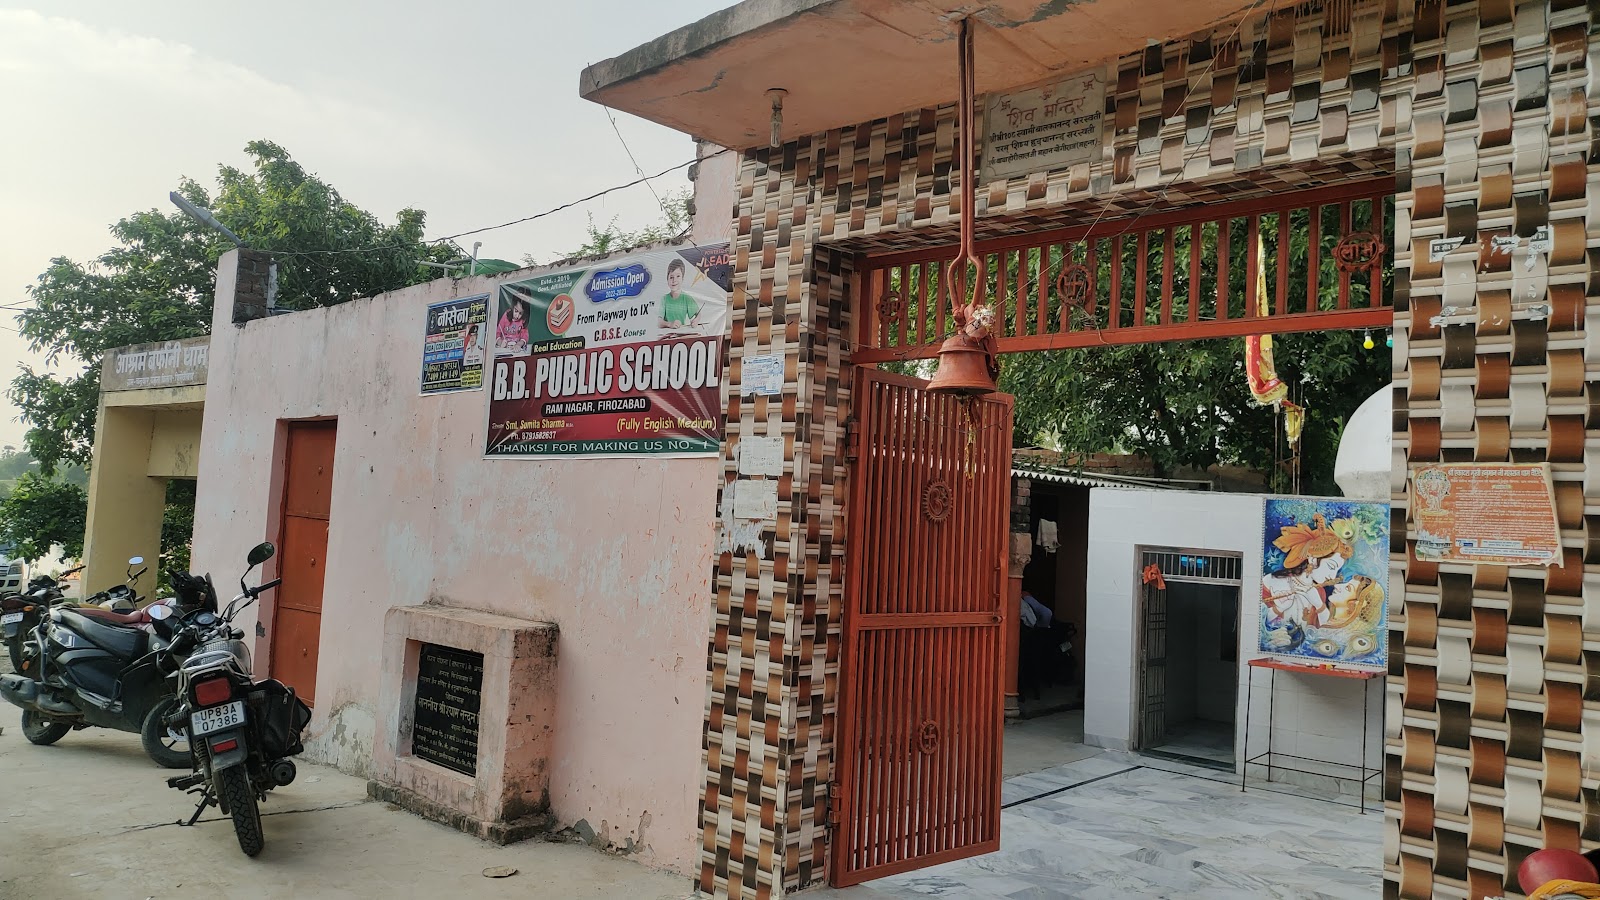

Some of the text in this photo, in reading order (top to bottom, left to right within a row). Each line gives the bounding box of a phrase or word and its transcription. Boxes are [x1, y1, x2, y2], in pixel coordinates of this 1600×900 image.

[1006, 96, 1086, 129] शिव मन्दिर
[1073, 110, 1101, 126] सरस्वती
[1066, 125, 1096, 138] सरस्वती
[704, 253, 730, 268] LEAD
[591, 272, 645, 292] Admission Open
[605, 288, 627, 299] 2022-2023
[437, 306, 470, 327] नौसेना
[576, 313, 595, 325] From
[596, 307, 629, 324] Playway
[630, 307, 638, 317] to
[623, 328, 647, 338] Course
[533, 340, 583, 353] Real Education
[116, 351, 148, 375] आश्रम
[493, 360, 530, 401] B.B.
[534, 349, 614, 398] PUBLIC
[618, 340, 719, 392] SCHOOL
[545, 398, 646, 414] RAM NAGAR, FIROZABAD
[541, 418, 565, 428] Sharma
[616, 416, 717, 433] (Fully English Medium)
[496, 443, 548, 453] THANKS!
[552, 443, 577, 452] FOR
[582, 441, 639, 451] MAKING
[644, 441, 663, 450] US
[668, 440, 694, 450] NO.
[200, 704, 237, 721] UP83A
[418, 697, 477, 725] माननीय श्री श्याम नन्दन
